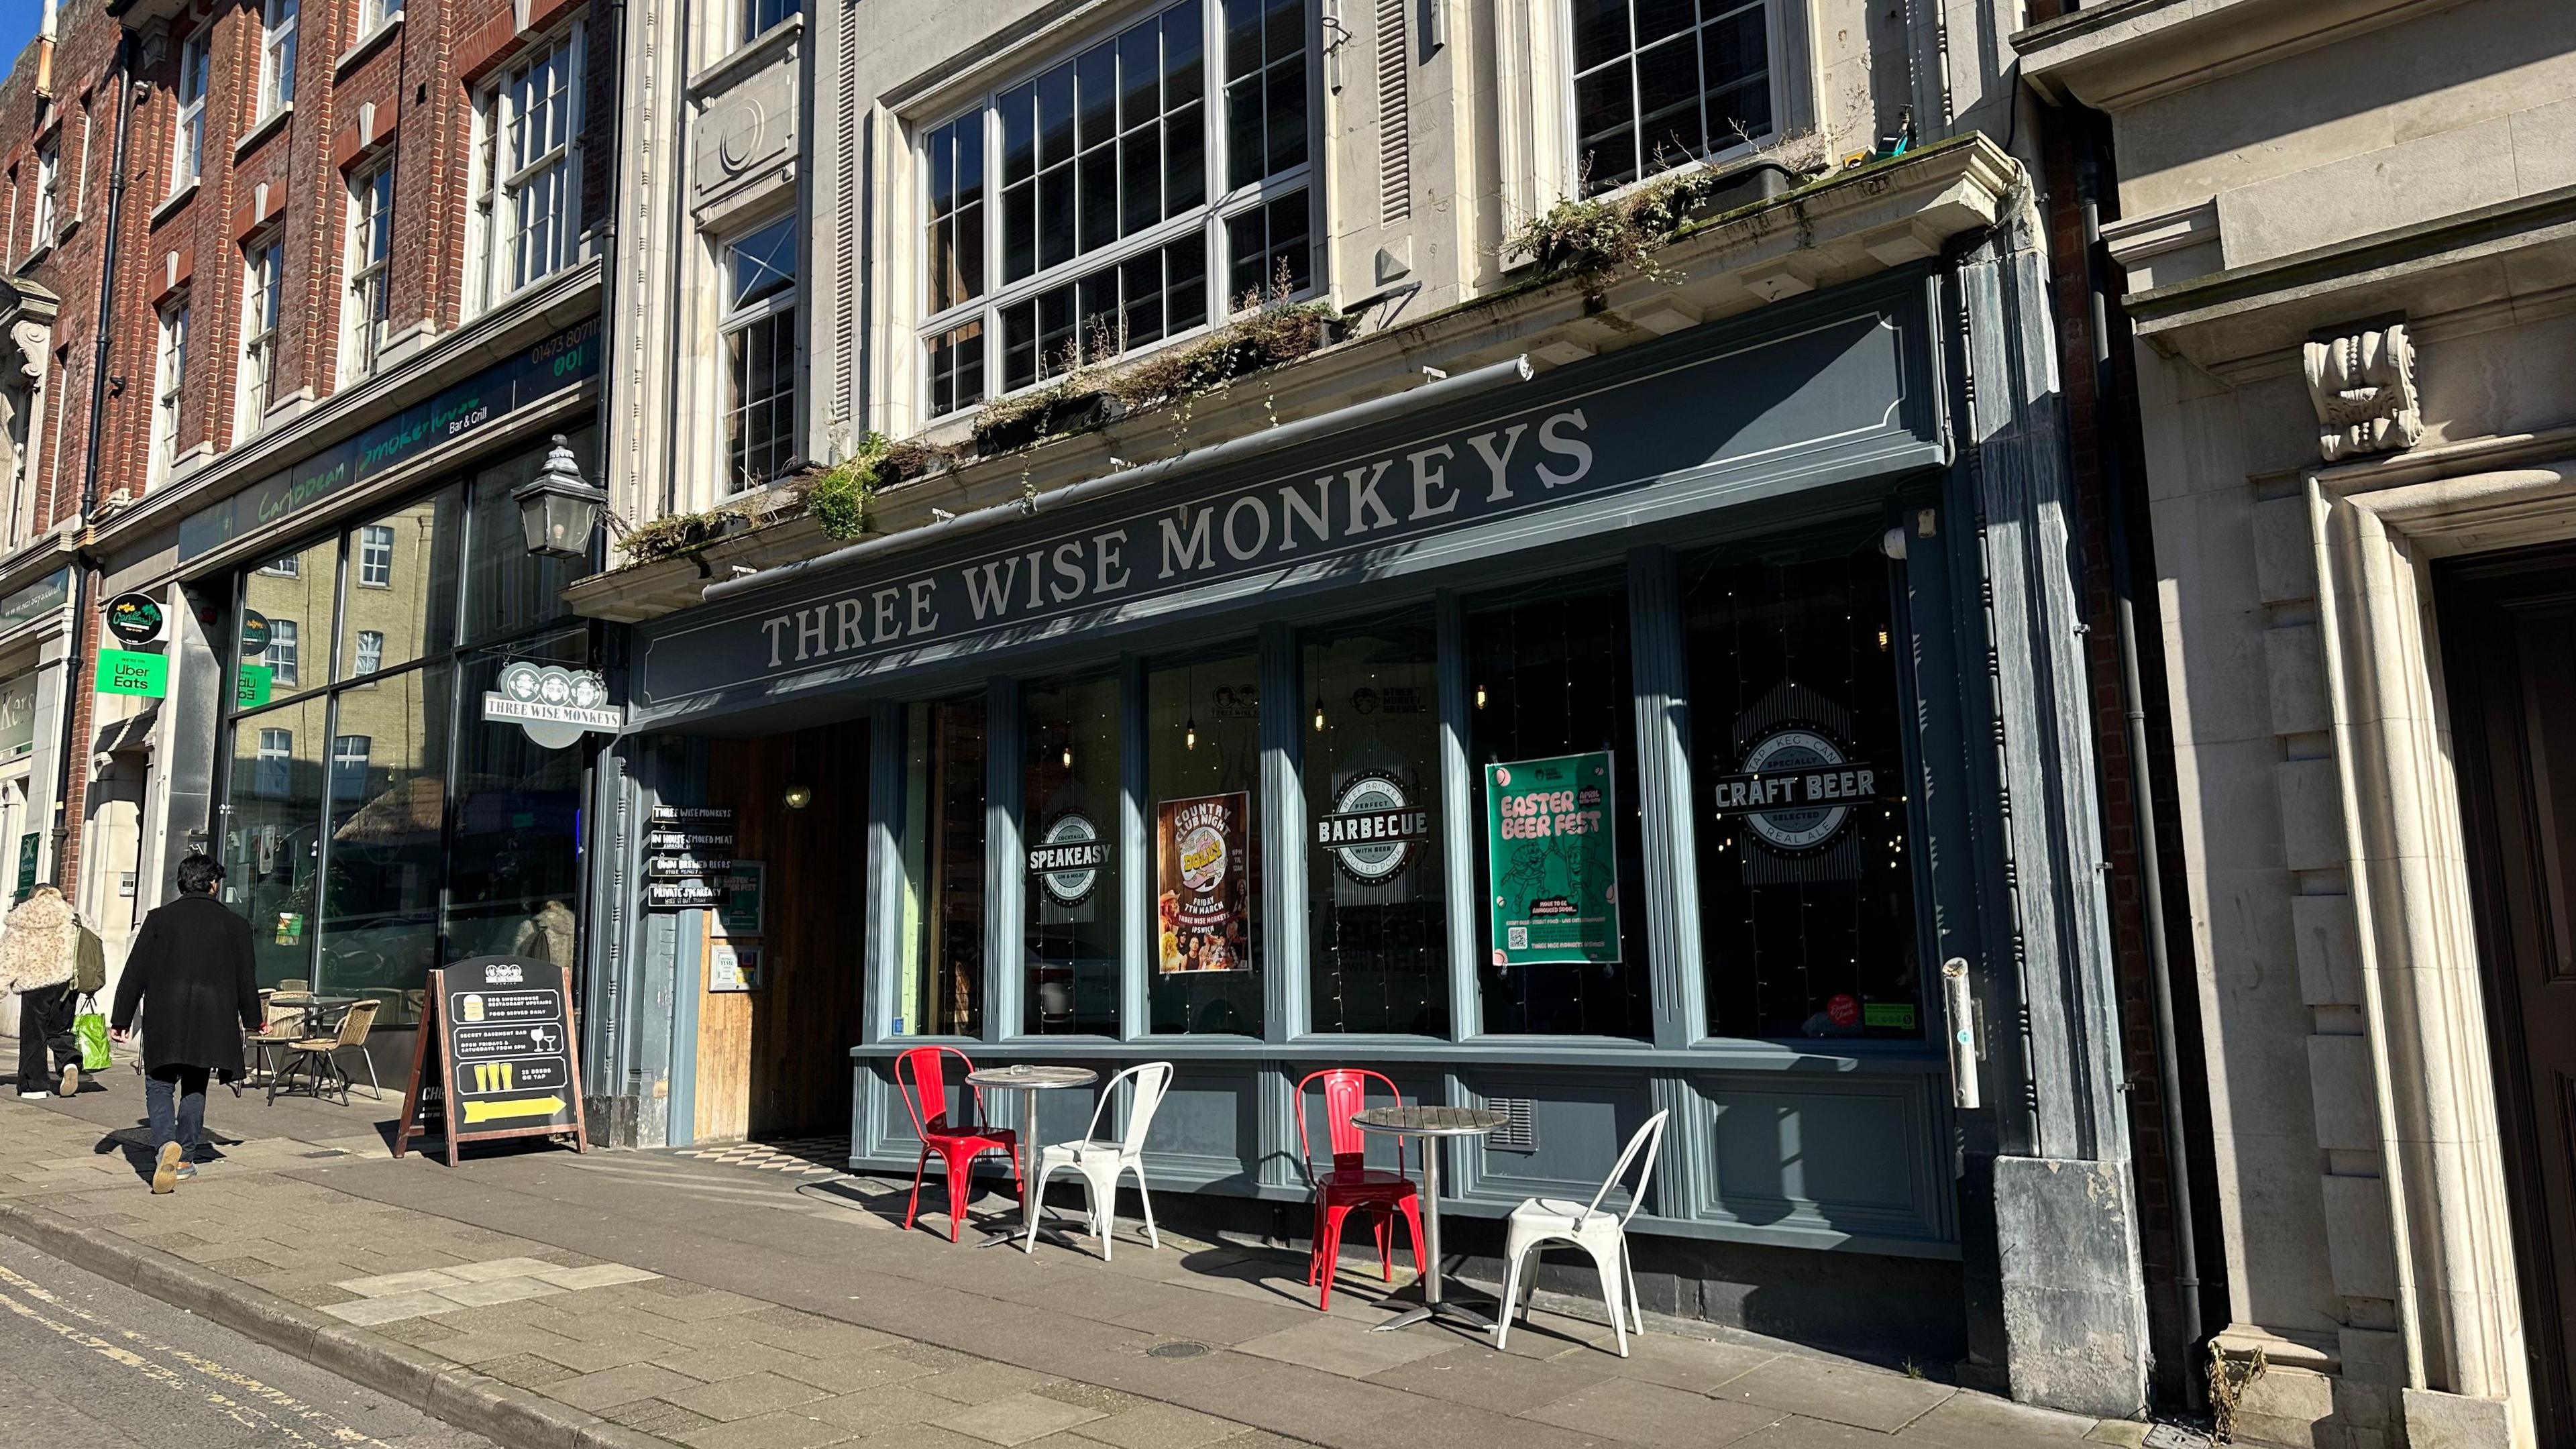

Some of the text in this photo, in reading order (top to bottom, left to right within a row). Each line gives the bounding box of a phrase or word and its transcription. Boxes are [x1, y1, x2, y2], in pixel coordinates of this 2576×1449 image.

[531, 337, 564, 364] 01473
[449, 407, 488, 435] Bar & Grill
[761, 408, 1593, 668] THREE WISE MONKEYS
[115, 663, 149, 677] Uber
[114, 676, 148, 689] Eats
[488, 700, 618, 725] THREE WISE MONKEYS
[1748, 735, 1836, 771] TAP KEG CAN
[1767, 756, 1817, 768] SPECIALLY
[1344, 782, 1402, 809] BEEF BRISKET
[1579, 790, 1601, 799] APRIL
[1715, 770, 1876, 808] CRAFT BEER
[654, 808, 731, 817] THREE WISE MONKEYS
[1175, 802, 1232, 826] COUNTRY
[1355, 800, 1388, 809] PERFECT
[1501, 790, 1574, 818] EASTER
[1175, 814, 1231, 841] CLUB NIGHT
[1318, 812, 1428, 843] BARBECUE
[1501, 810, 1601, 840] BEER FEST
[1772, 812, 1820, 822] SELECTED
[651, 834, 733, 844] IN HOUSE SMOKED MEAT
[1049, 819, 1071, 841] SECRET
[1082, 821, 1093, 837] BAR
[1766, 820, 1832, 844] REAL ALE
[657, 860, 731, 869] OWN BREWED BEERS
[1030, 844, 1112, 869] SPEAKEASY
[1183, 840, 1222, 872] DOLLY
[1346, 850, 1403, 873] PULLED PORK
[653, 888, 721, 898] PRIVATE SPEAKEASY
[1051, 876, 1091, 896] IN BASEMENT
[1185, 901, 1224, 914] 7TH MARCH
[1193, 896, 1214, 906] FRIDAY
[1178, 914, 1193, 924] THREE
[1206, 911, 1230, 923] MONKEYS
[1191, 925, 1214, 934] IPSWICH
